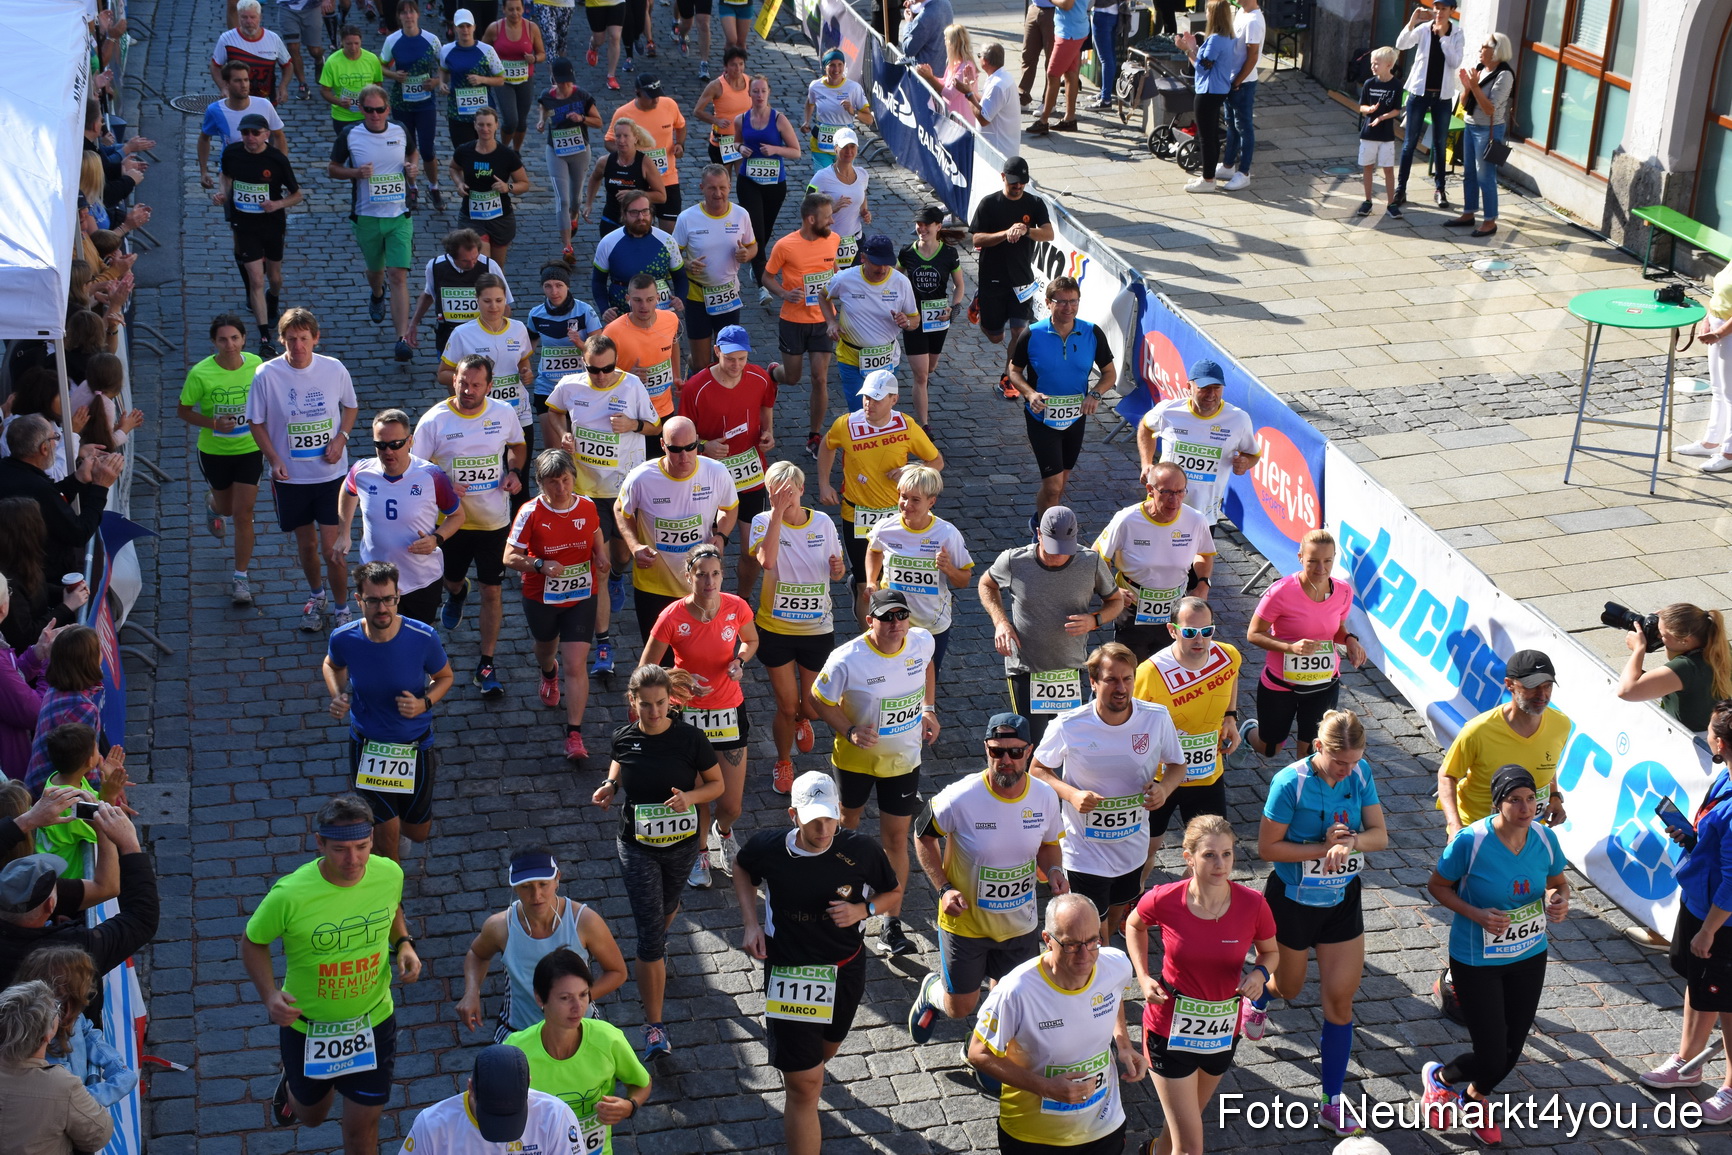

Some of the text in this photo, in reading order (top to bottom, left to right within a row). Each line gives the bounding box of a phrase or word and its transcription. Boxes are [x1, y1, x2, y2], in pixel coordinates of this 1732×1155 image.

[505, 67, 527, 77] 1333
[405, 84, 424, 94] 260
[457, 87, 486, 97] BOCK
[460, 96, 485, 107] 2596
[553, 127, 580, 139] BOCK
[556, 137, 580, 148] 2316
[474, 162, 490, 170] RUN
[748, 159, 778, 168] BOCK
[372, 173, 403, 184] BOCK
[750, 167, 776, 177] 2328
[236, 183, 268, 192] BOCK
[374, 183, 402, 195] 2526
[237, 192, 265, 203] 2619
[373, 194, 402, 202] CHRISTIAN
[471, 191, 500, 201] BOCK
[472, 198, 498, 211] 2174
[837, 246, 856, 257] 076
[443, 288, 477, 298] BOCK
[705, 281, 735, 294] BOCK
[709, 290, 736, 305] 2356
[447, 300, 478, 311] 1250
[715, 303, 734, 312] GEORG
[542, 347, 581, 357] BOCK
[862, 344, 893, 356] BOCK
[546, 358, 579, 370] 2269
[864, 354, 891, 368] 3005
[646, 372, 669, 387] 537
[1047, 395, 1083, 406] BOCK
[1049, 407, 1081, 420] 2052
[291, 421, 332, 433] BOCK
[294, 433, 330, 448] 2839
[577, 429, 615, 443] BOCK
[852, 433, 910, 452] MAX BÖGL
[579, 441, 614, 457] 1205
[1177, 442, 1221, 457] BOCK
[456, 456, 496, 467] BOCK
[580, 456, 611, 466] MICHAEL
[1177, 456, 1214, 473] 2097
[458, 469, 495, 482] 2342
[1254, 432, 1316, 529] Hervis
[468, 484, 492, 492] ONALD
[385, 498, 398, 521] 6
[657, 515, 702, 530] BOCK
[660, 529, 699, 544] 2766
[892, 556, 936, 571] BOCK
[551, 576, 587, 592] 2782
[893, 569, 934, 586] 2630
[779, 583, 823, 595] BOCK
[901, 585, 926, 594] TANJA
[1143, 590, 1181, 600] BOCK
[779, 596, 819, 611] 2633
[1143, 602, 1170, 615] 205
[781, 611, 815, 620] BETTINA
[1146, 616, 1171, 624] ALFRE
[1291, 656, 1331, 671] 1390
[1034, 670, 1078, 681] BOCK
[1036, 684, 1075, 699] 2025
[1172, 668, 1237, 708] MAX BÖGL
[884, 688, 925, 711] BOCK
[1040, 699, 1073, 709] JÜRGEN
[690, 712, 731, 728] 1111
[886, 703, 921, 726] 2048
[889, 719, 919, 735] JÜRGEN
[706, 730, 724, 739] ULIA
[1182, 735, 1213, 748] OCK
[367, 743, 413, 758] BOCK
[1186, 749, 1213, 765] 386
[367, 757, 409, 776] 1170
[365, 777, 404, 788] MICHAEL
[1096, 794, 1143, 809] BOCK
[1022, 810, 1033, 819] 20
[1092, 810, 1137, 828] 2651
[643, 818, 691, 837] 1110
[1094, 827, 1135, 838] STEPHAN
[644, 833, 689, 845] STEFANIE
[982, 861, 1034, 882] BOCK
[1318, 877, 1347, 886] KATHI
[985, 881, 1031, 898] 2026
[988, 896, 1027, 909] MARKUS
[311, 906, 392, 952] OPF
[1495, 938, 1537, 953] KERSTIN
[318, 952, 382, 978] MERZ
[775, 964, 831, 979] BOCK
[318, 967, 379, 988] PREMIUM
[317, 980, 378, 1000] REISEN
[776, 981, 827, 1003] 1112
[1091, 995, 1104, 1007] 20
[1182, 999, 1235, 1016] BOCK
[780, 1004, 817, 1015] MARCO
[312, 1017, 370, 1037] BOCK
[1039, 1018, 1064, 1029] BOCK
[1179, 1018, 1230, 1036] 2244
[313, 1034, 367, 1060] 2088
[1183, 1038, 1222, 1049] TERESA
[326, 1059, 355, 1073] JÖRG
[507, 1142, 523, 1152] 20
